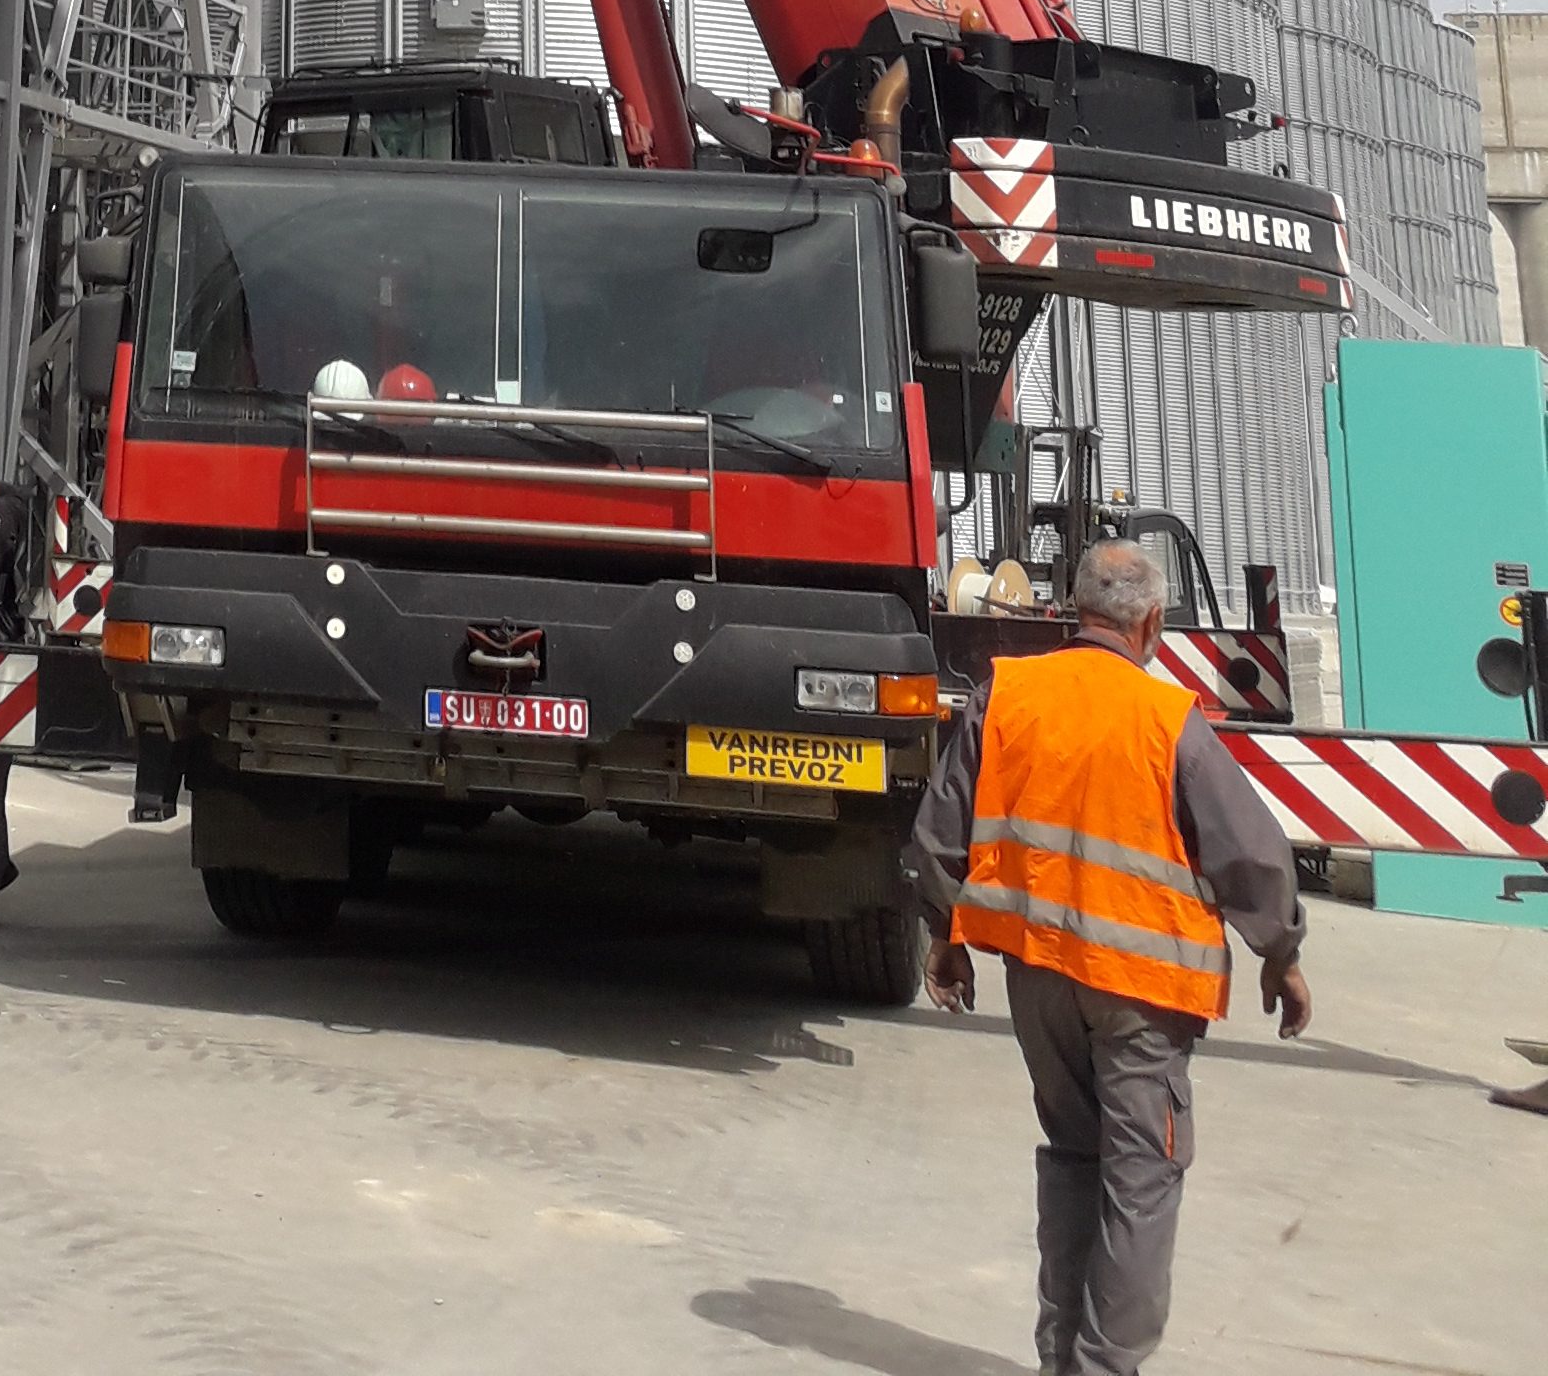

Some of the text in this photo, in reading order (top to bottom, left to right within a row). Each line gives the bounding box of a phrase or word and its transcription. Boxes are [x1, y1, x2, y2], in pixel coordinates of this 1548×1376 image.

[1130, 194, 1312, 254] LIEBHERR
[445, 695, 475, 724] SU
[708, 731, 863, 764] VANREDNI
[728, 754, 845, 784] PREVOZ
